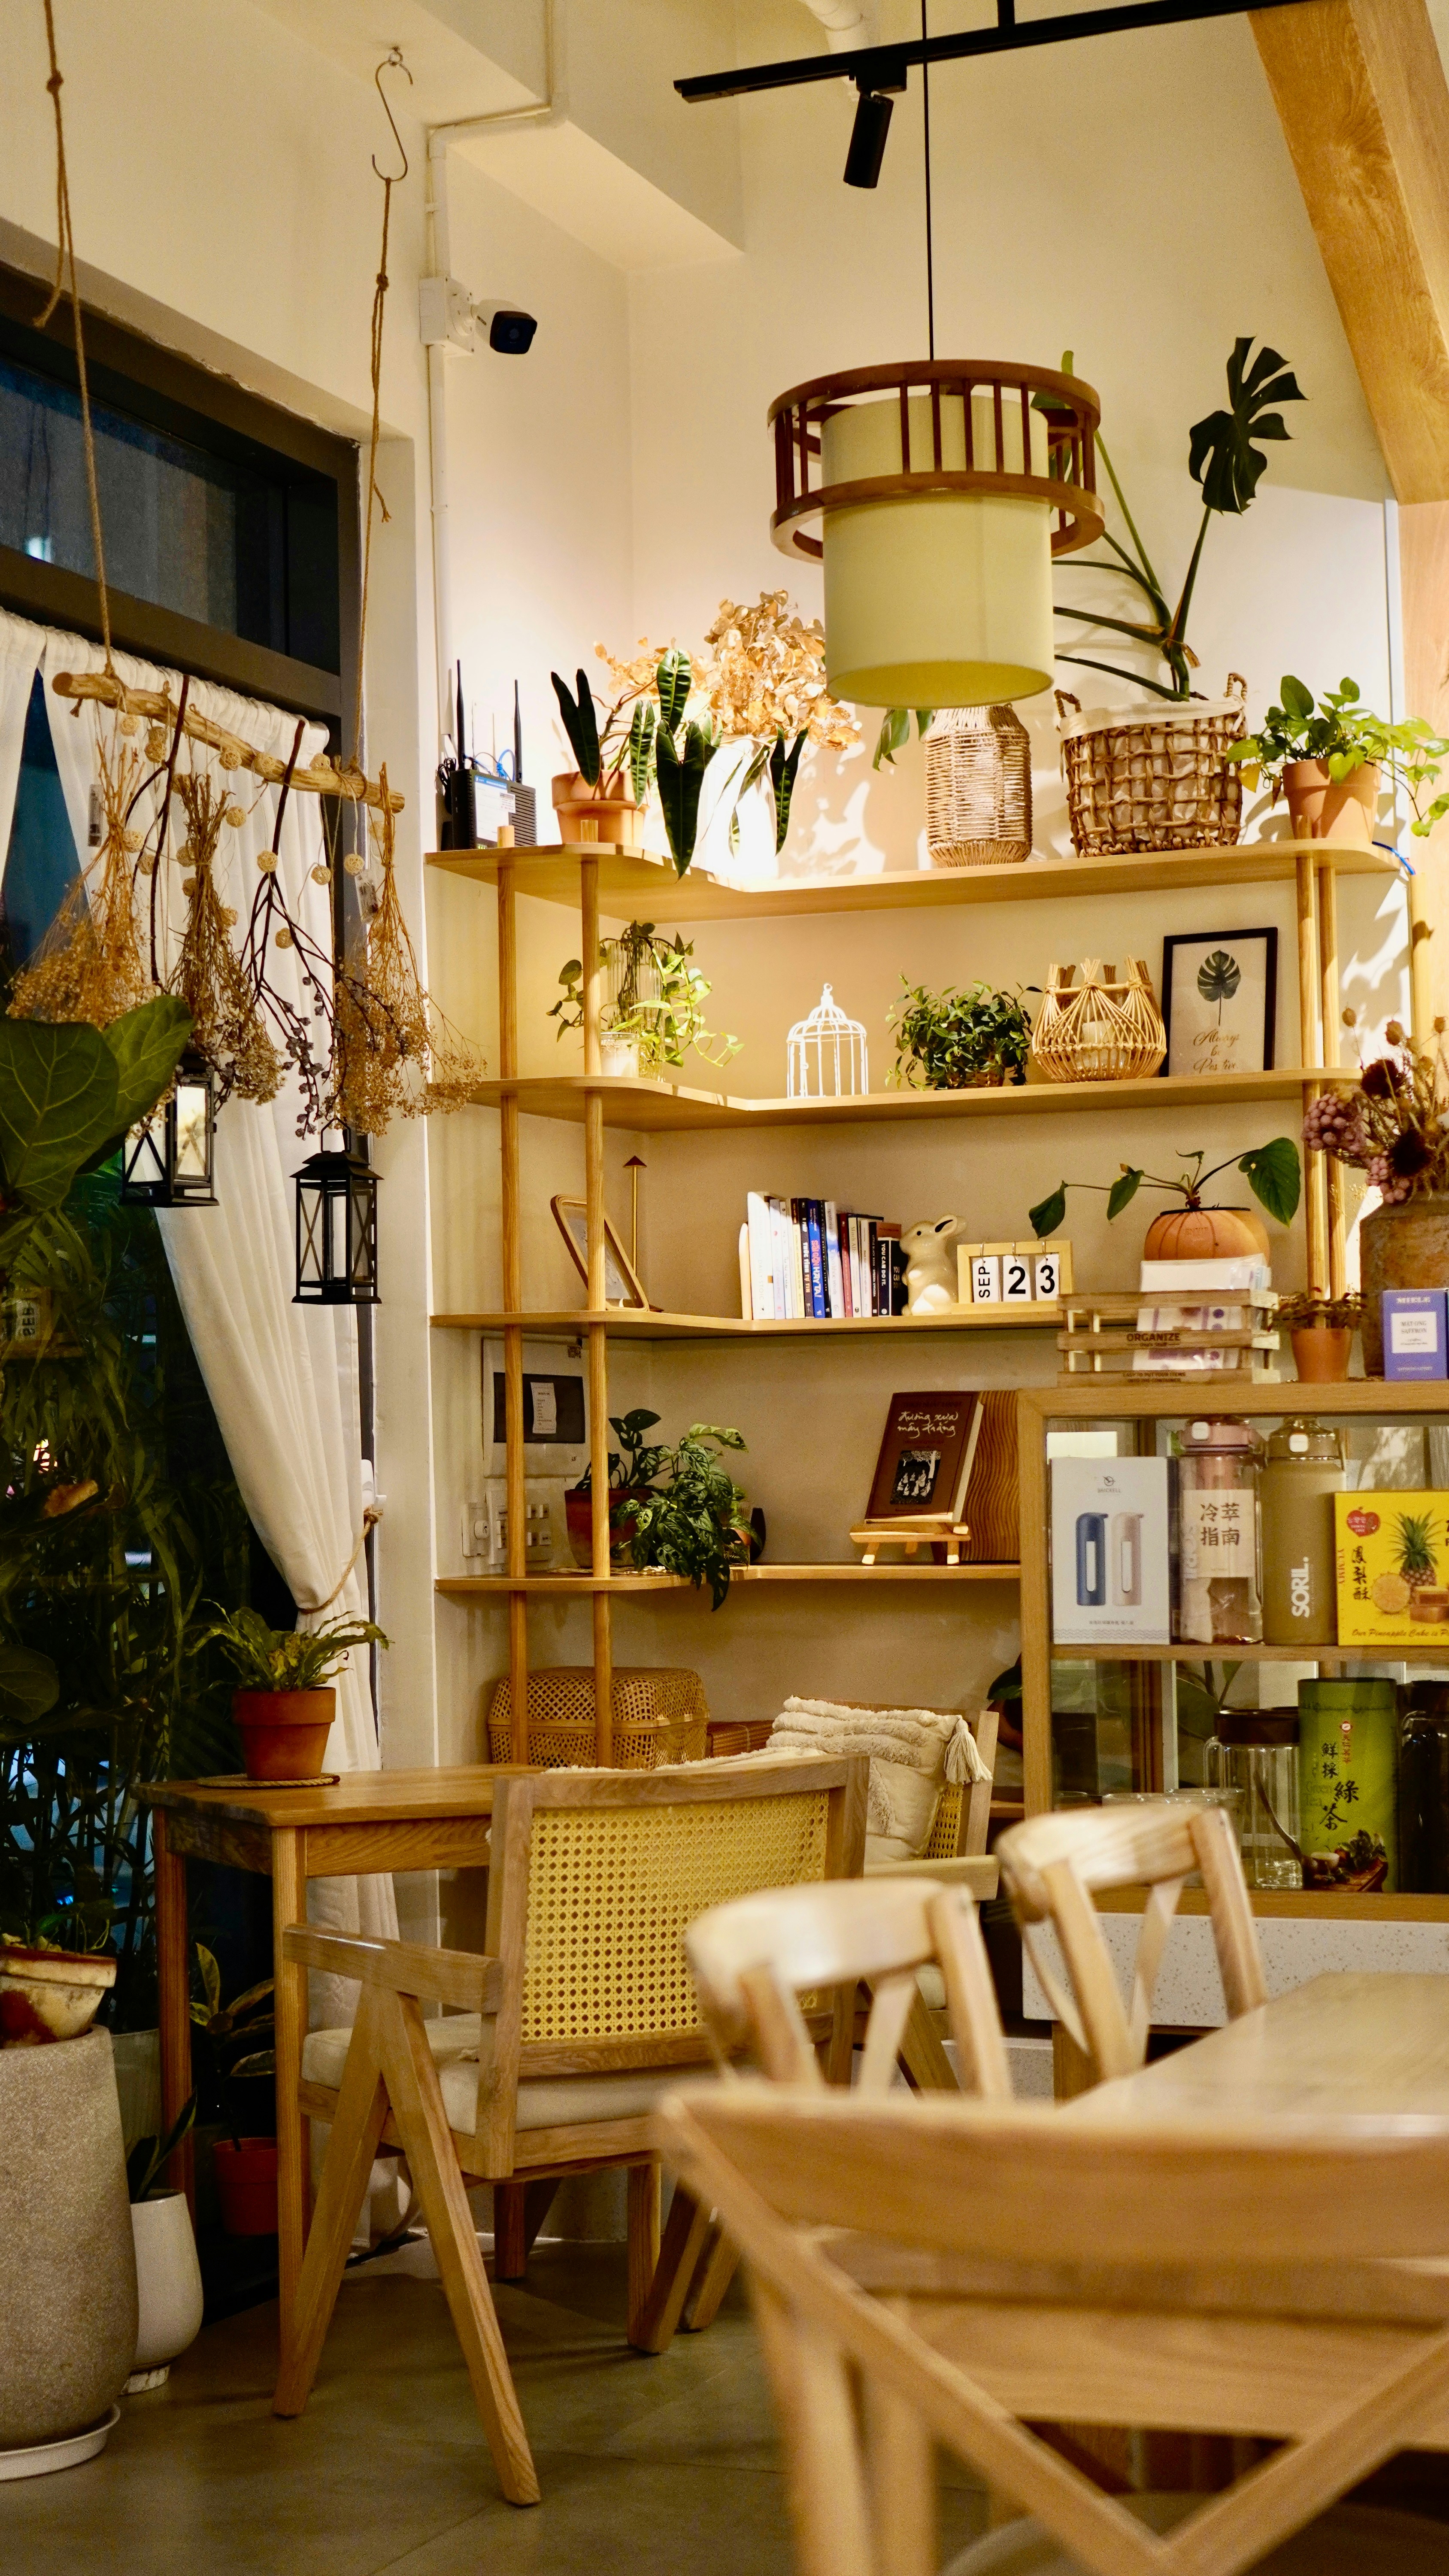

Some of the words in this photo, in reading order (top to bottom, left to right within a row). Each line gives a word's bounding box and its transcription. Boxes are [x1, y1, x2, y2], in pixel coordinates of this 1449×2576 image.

[1194, 1029, 1239, 1048] Always
[1194, 1058, 1236, 1074] Postive
[812, 1266, 821, 1283] HAY
[881, 1270, 886, 1279] DO
[979, 1266, 990, 1298] SEP
[1127, 1333, 1181, 1341] ORGANIZE
[1200, 1503, 1240, 1522] 冷萃
[1200, 1527, 1240, 1546] 指南
[1337, 1548, 1346, 1585] YUMMY
[1352, 1546, 1371, 1601] 鳳梨酥
[1369, 1628, 1407, 1637] Pineapple
[1409, 1629, 1429, 1637] Cake
